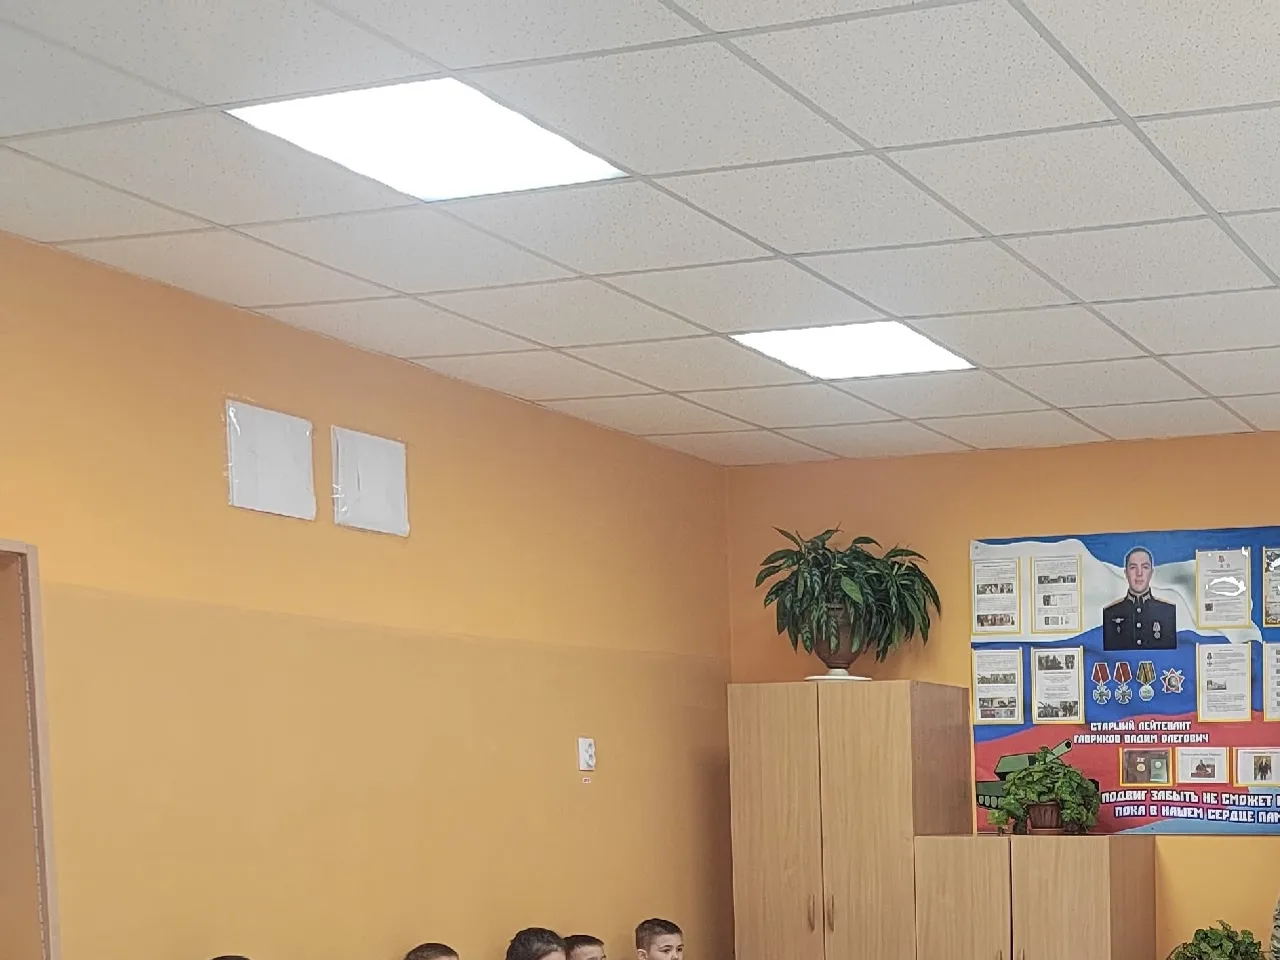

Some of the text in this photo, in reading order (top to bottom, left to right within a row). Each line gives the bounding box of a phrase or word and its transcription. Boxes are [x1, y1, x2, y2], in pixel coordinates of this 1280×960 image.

[1101, 790, 1148, 803] ПОДВИГ
[1150, 790, 1199, 803] ЗАБЫТЬ
[1202, 792, 1218, 804] НЕ
[1221, 793, 1273, 806] СМОЖЕТ
[1114, 805, 1146, 817] ПОКА
[1149, 805, 1158, 816] В
[1161, 806, 1203, 819] НАШЕМ
[1207, 809, 1255, 822] СЕРДЦЕ
